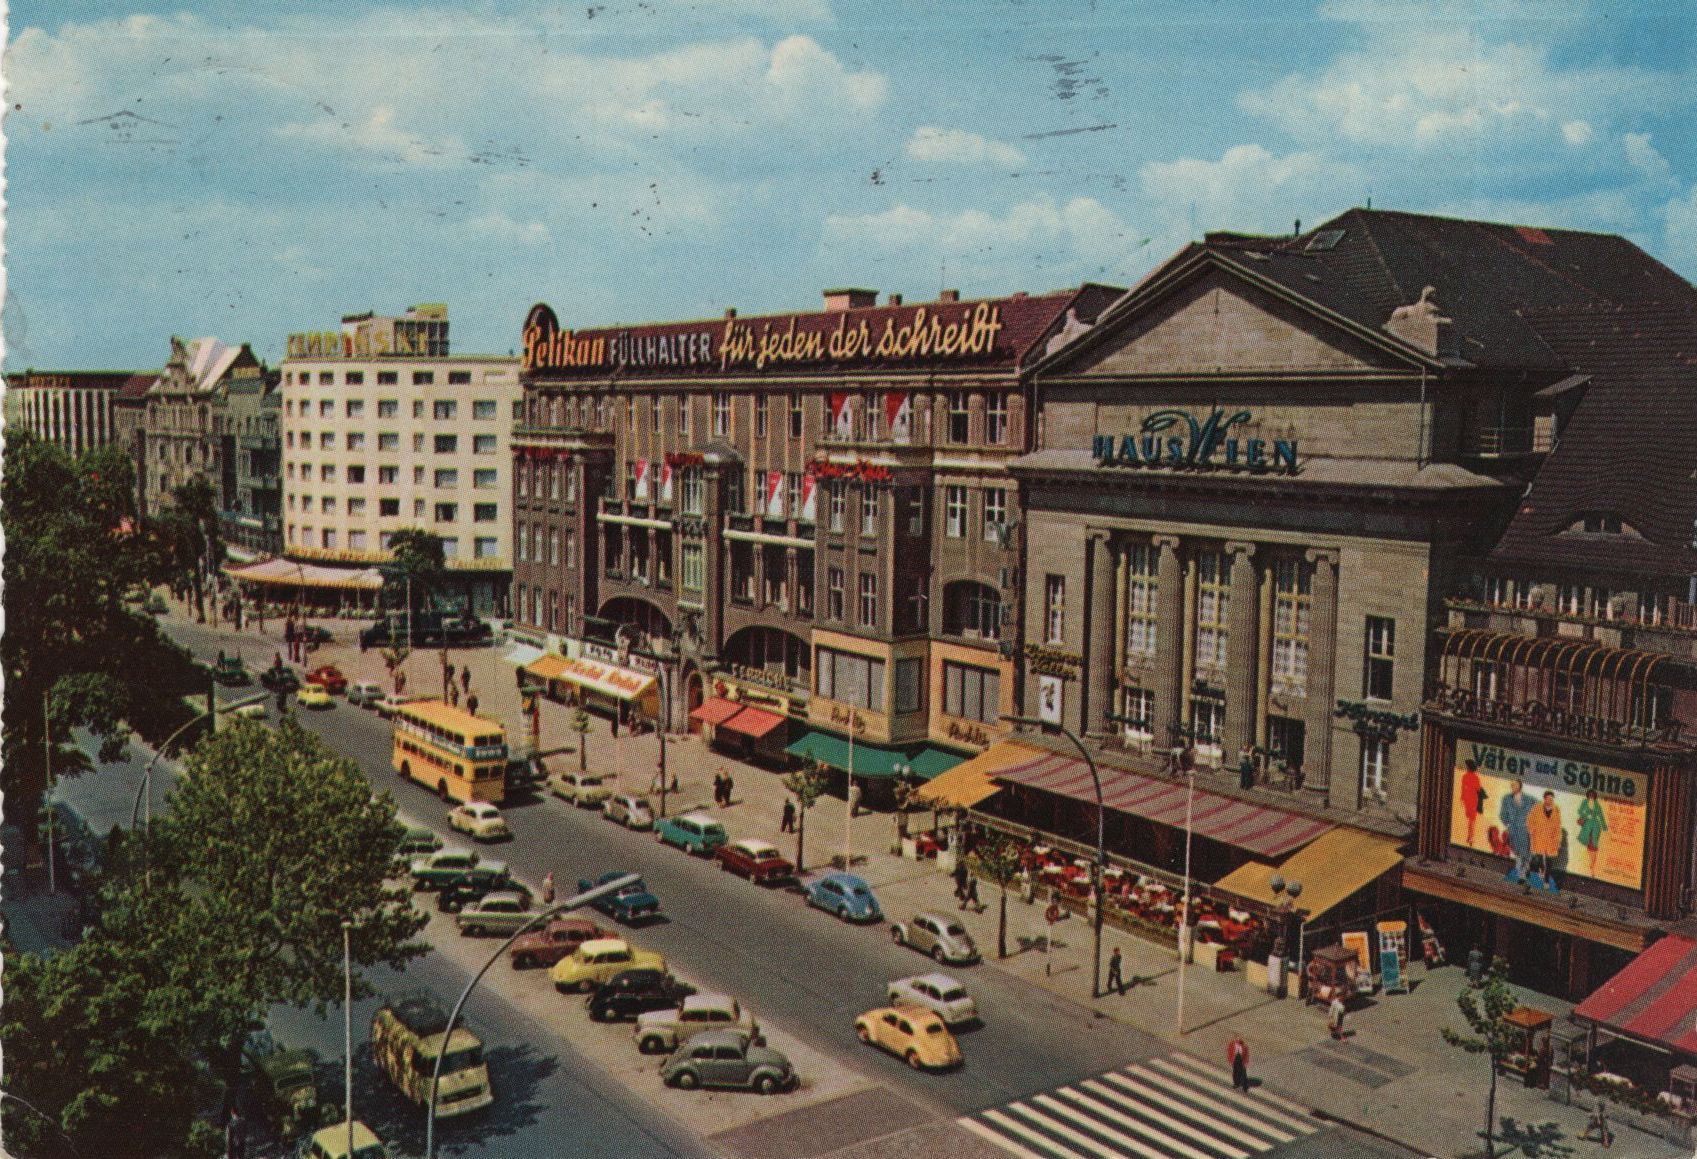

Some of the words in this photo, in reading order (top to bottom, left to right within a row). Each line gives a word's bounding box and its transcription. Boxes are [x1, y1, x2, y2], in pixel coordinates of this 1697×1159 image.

[522, 321, 605, 369] Pelikan
[609, 331, 711, 366] FÜLLHALTER
[719, 321, 755, 372] für
[756, 315, 825, 370] jeden
[830, 313, 872, 358] der
[874, 303, 1002, 356] schreibt
[1092, 433, 1184, 465] HAUS
[1141, 408, 1298, 470] WIEN
[1471, 743, 1531, 776] Väter
[1535, 759, 1559, 776] und
[1562, 762, 1636, 798] Söhne
